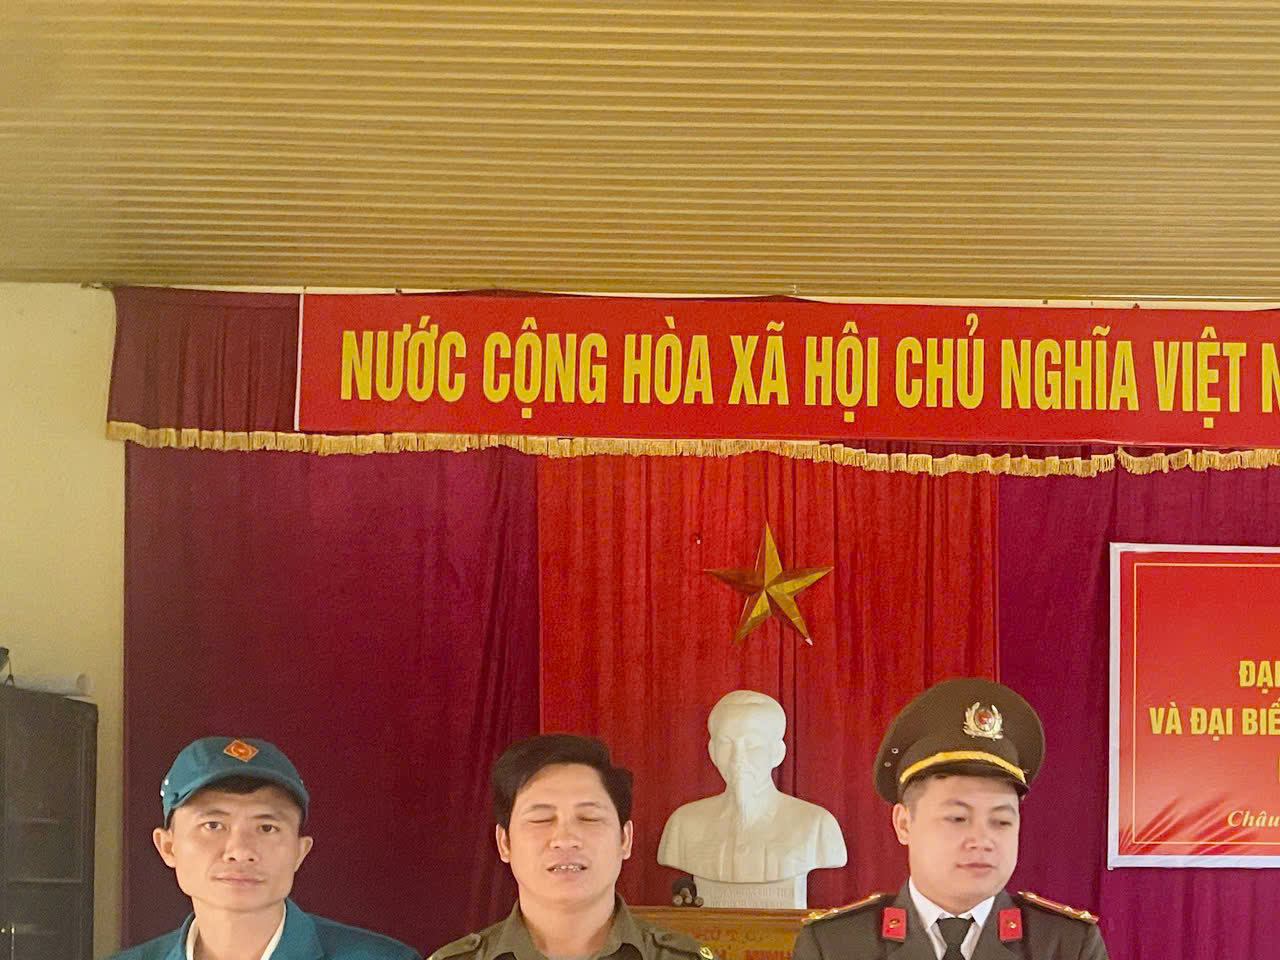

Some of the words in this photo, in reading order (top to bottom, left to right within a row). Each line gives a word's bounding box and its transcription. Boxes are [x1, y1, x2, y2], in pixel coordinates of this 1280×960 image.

[340, 315, 467, 403] NƯỚC
[483, 317, 607, 419] CỘNG
[623, 317, 713, 405] HÒA
[728, 322, 789, 406] XÃ
[805, 322, 879, 423] HỘI
[896, 313, 985, 409] CHỦ
[1001, 326, 1139, 411] NGHĨA
[1153, 327, 1246, 428] VIỆT
[1149, 701, 1183, 735] VÀ
[1190, 707, 1233, 742] ĐẠI
[1227, 810, 1280, 828] Châu
